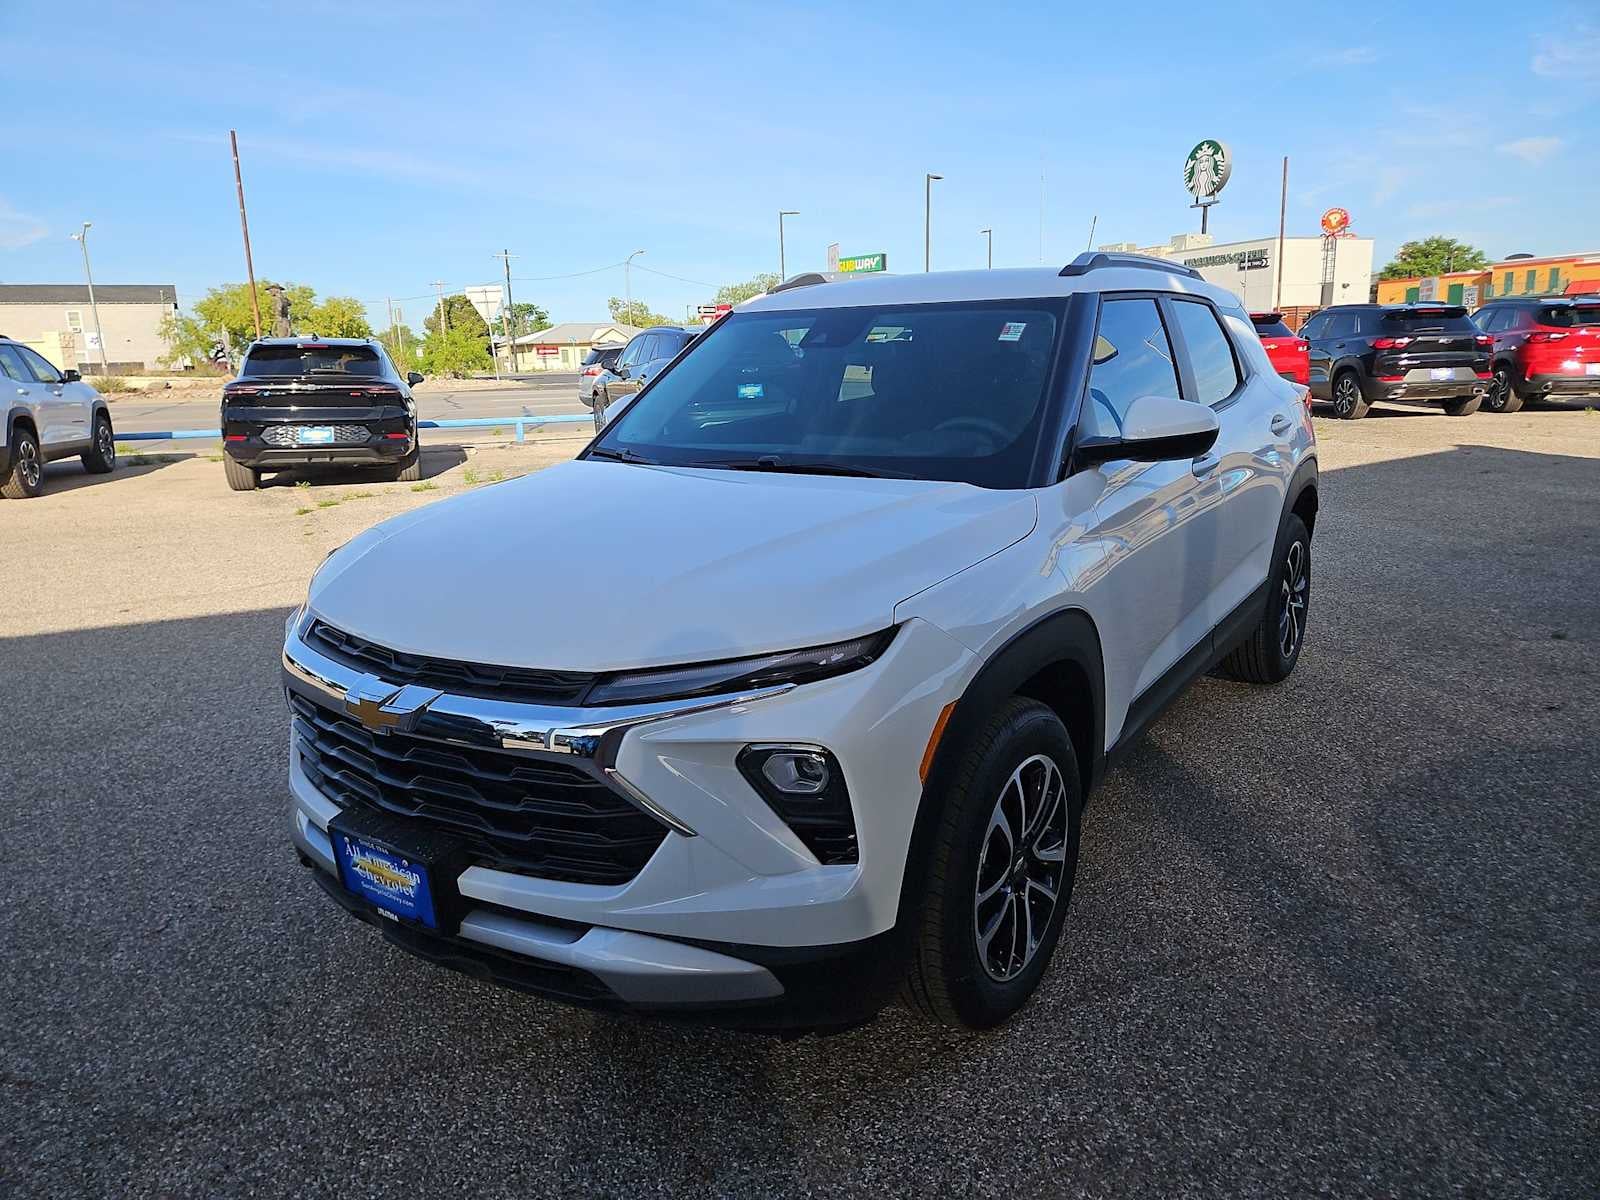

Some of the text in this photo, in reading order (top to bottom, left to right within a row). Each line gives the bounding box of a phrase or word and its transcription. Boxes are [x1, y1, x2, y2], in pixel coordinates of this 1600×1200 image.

[838, 257, 878, 272] SUBWAY
[1464, 297, 1475, 305] 35
[345, 843, 421, 885] All American
[352, 864, 415, 898] Chevrolet
